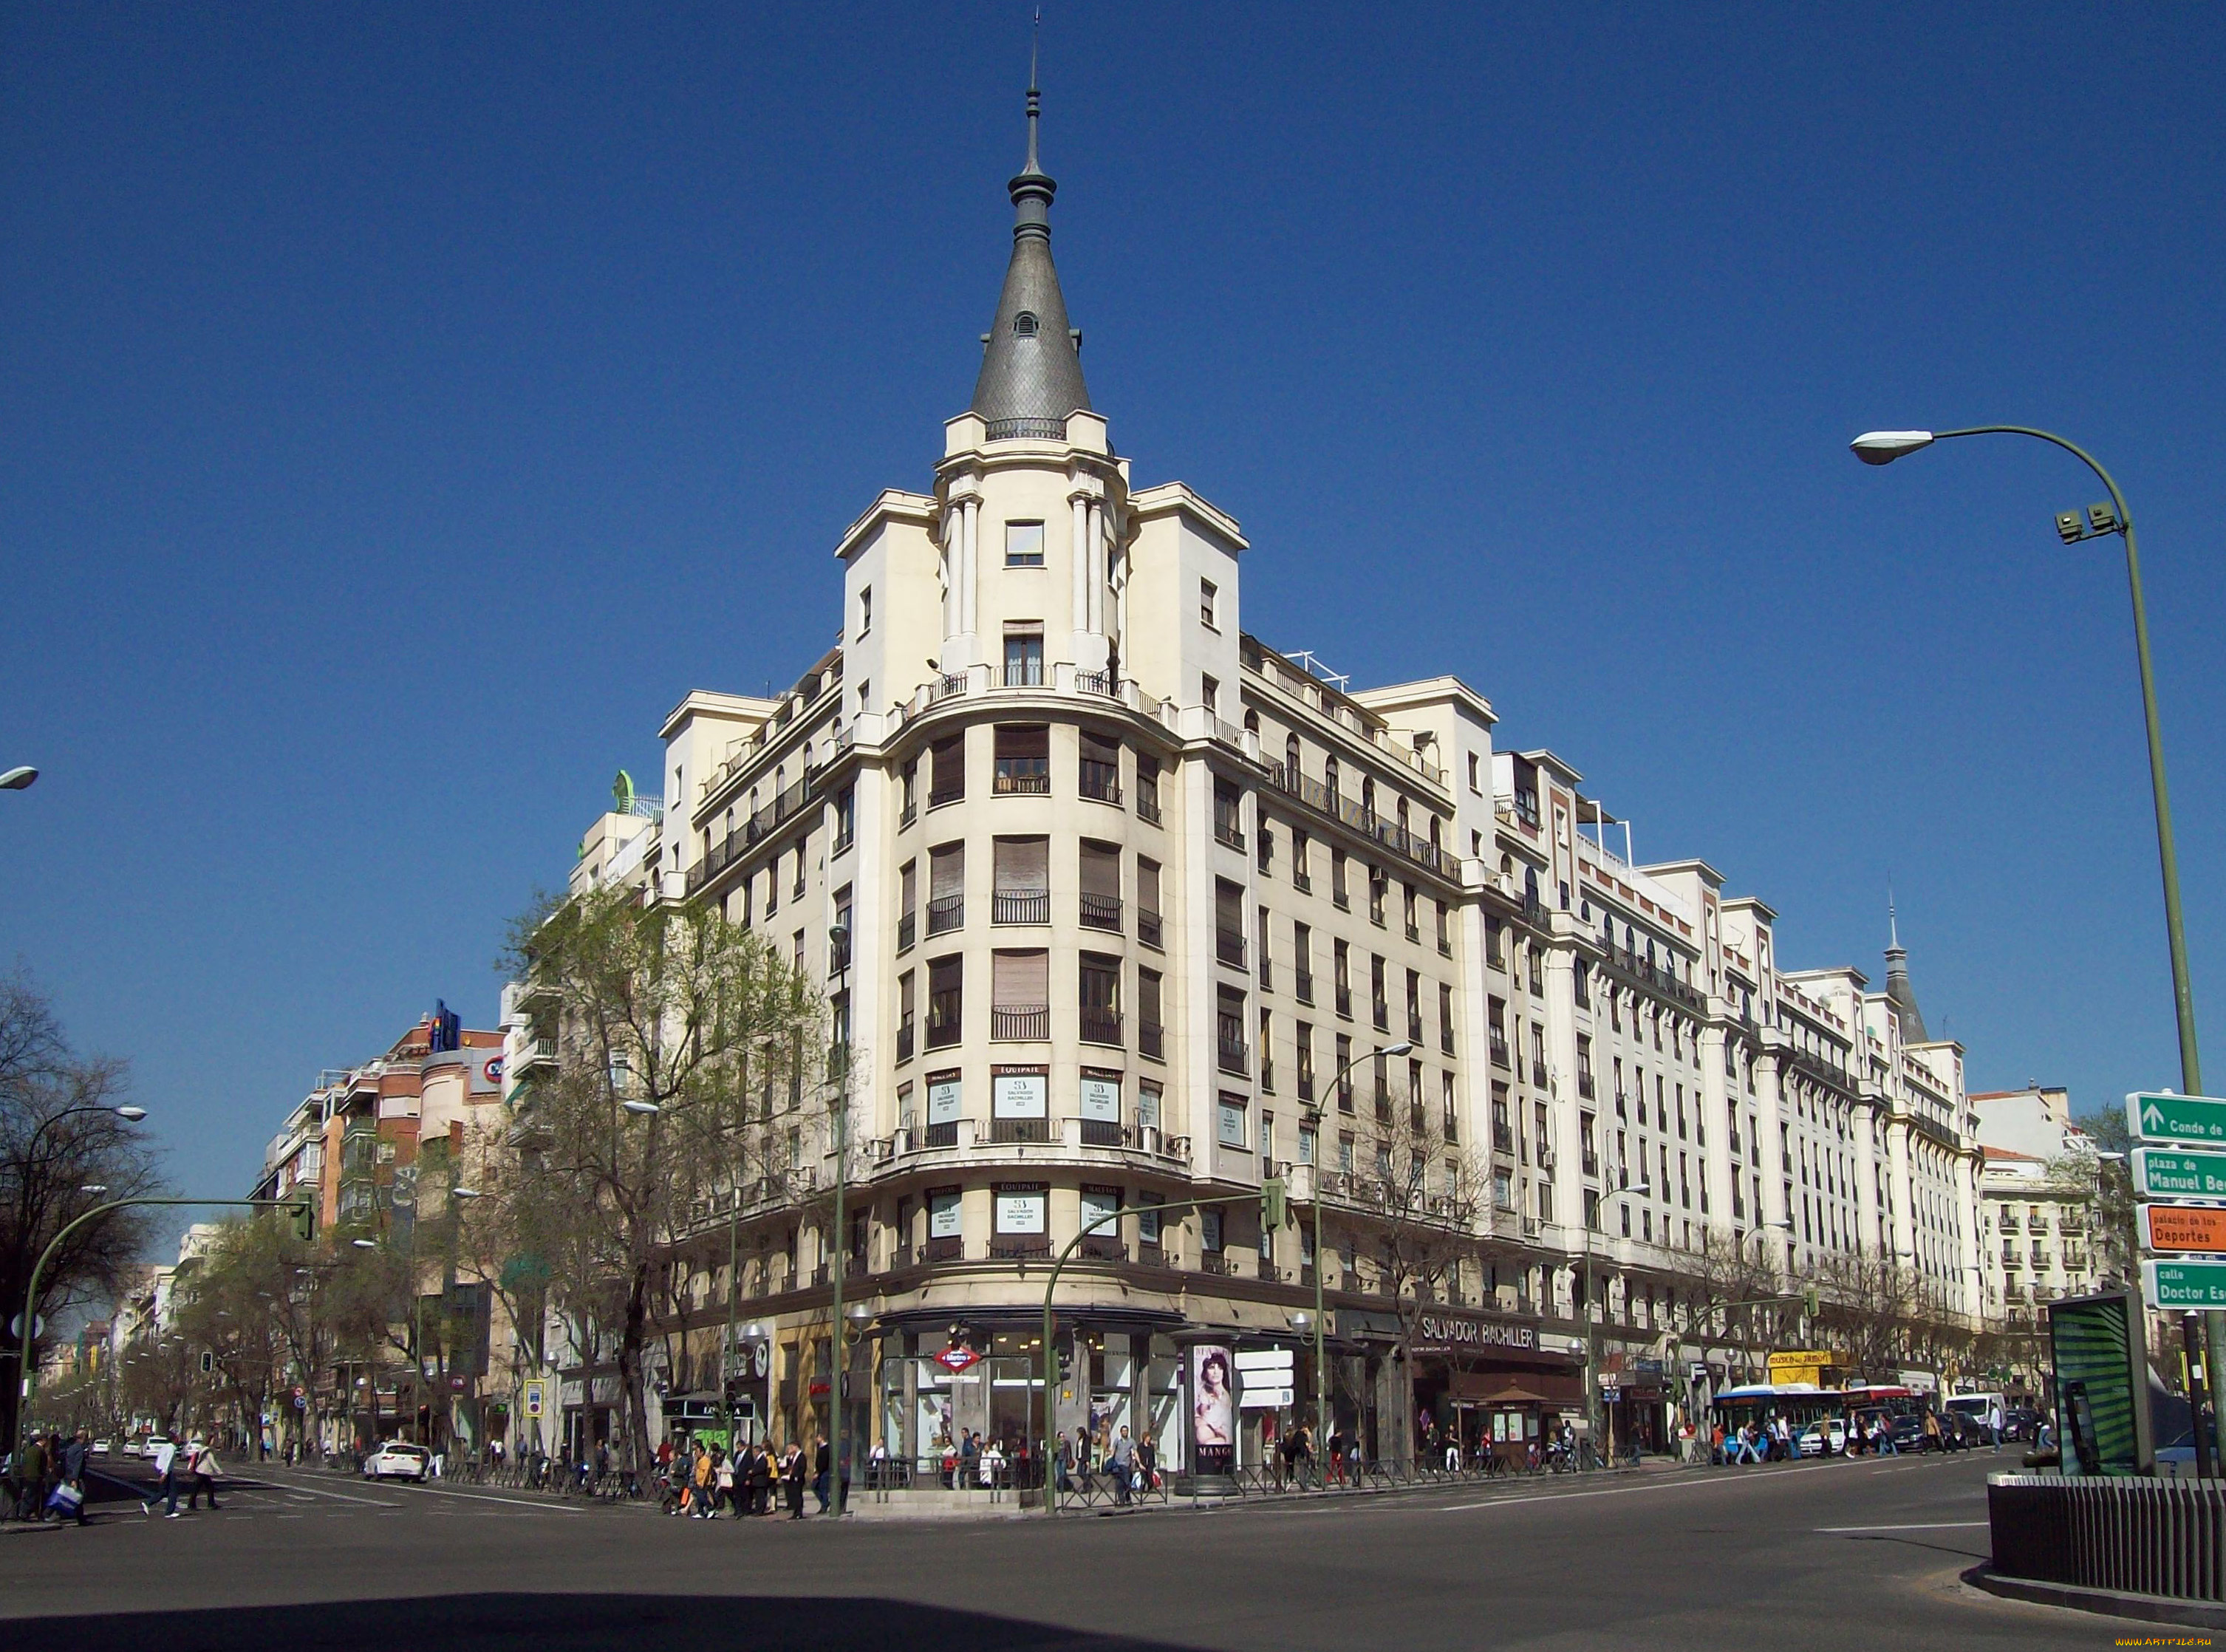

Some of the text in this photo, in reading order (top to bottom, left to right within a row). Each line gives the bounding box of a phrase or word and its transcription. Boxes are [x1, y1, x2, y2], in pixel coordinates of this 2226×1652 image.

[2170, 1119, 2222, 1136] Conde de
[2148, 1157, 2196, 1171] plaza de
[2149, 1172, 2226, 1191] Manuel Be
[2154, 1215, 2216, 1226] palacio de los
[2155, 1228, 2210, 1244] Deportes
[2159, 1269, 2184, 1280] calle
[2160, 1284, 2204, 1300] Doctor
[1422, 1317, 1534, 1349] SALVADOR BACHILLER
[946, 1354, 966, 1362] Metro
